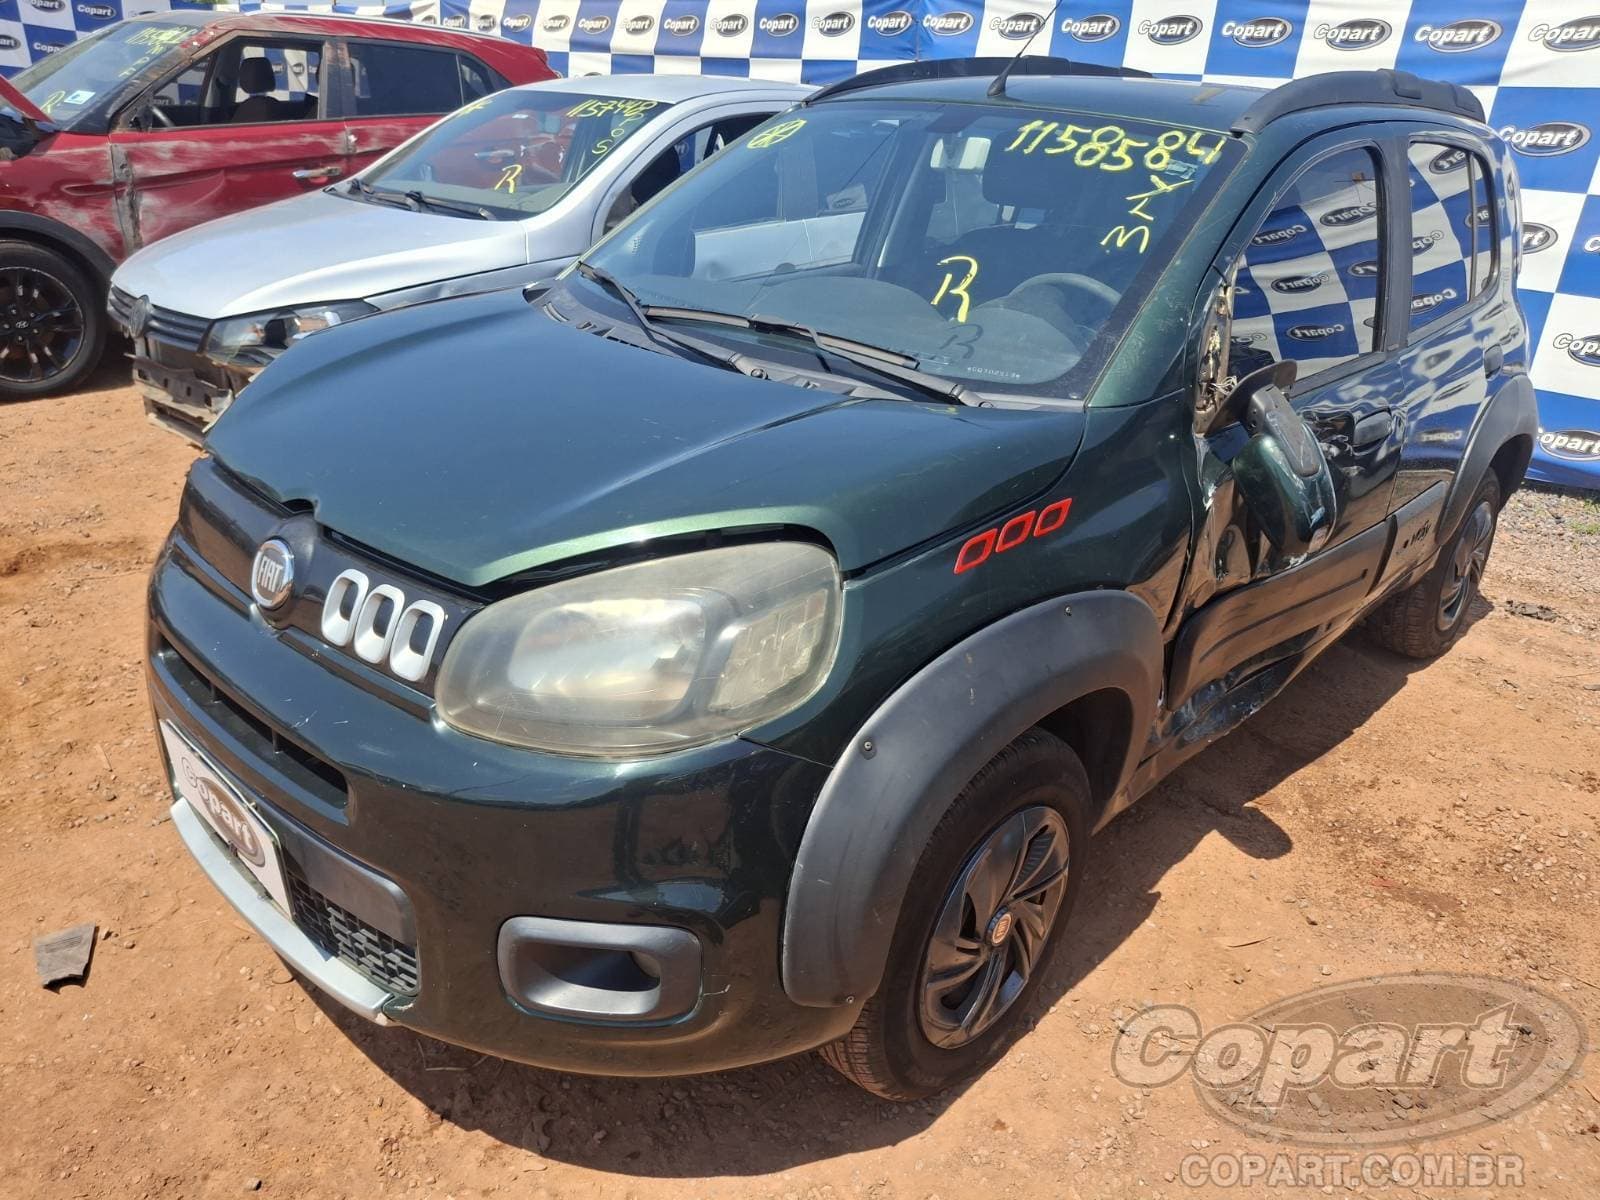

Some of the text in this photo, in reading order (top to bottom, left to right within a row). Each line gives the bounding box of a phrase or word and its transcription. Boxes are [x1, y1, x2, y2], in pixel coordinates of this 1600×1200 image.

[77, 4, 112, 16] Copart
[503, 16, 531, 28] Copart
[578, 18, 608, 30] Copart
[664, 19, 696, 31] Copart
[710, 19, 744, 33] Copart
[759, 18, 796, 32] Copart
[811, 16, 849, 31] Copart
[867, 15, 908, 30] Copart
[922, 14, 969, 30] Copart
[990, 17, 1043, 34] Copart
[1060, 18, 1114, 34] Copart
[1138, 19, 1199, 37] Copart
[1220, 20, 1284, 39] Copart
[1313, 23, 1382, 42] Copart
[1413, 25, 1492, 44] Copart
[1528, 23, 1600, 44] Copar
[1004, 119, 1228, 172] 1158584
[1499, 126, 1580, 148] Copart
[494, 164, 522, 194] R
[929, 254, 979, 324] R
[1553, 333, 1600, 357] Cop
[1537, 427, 1600, 454] opart
[257, 555, 285, 593] FIAT
[181, 756, 256, 852] Copart
